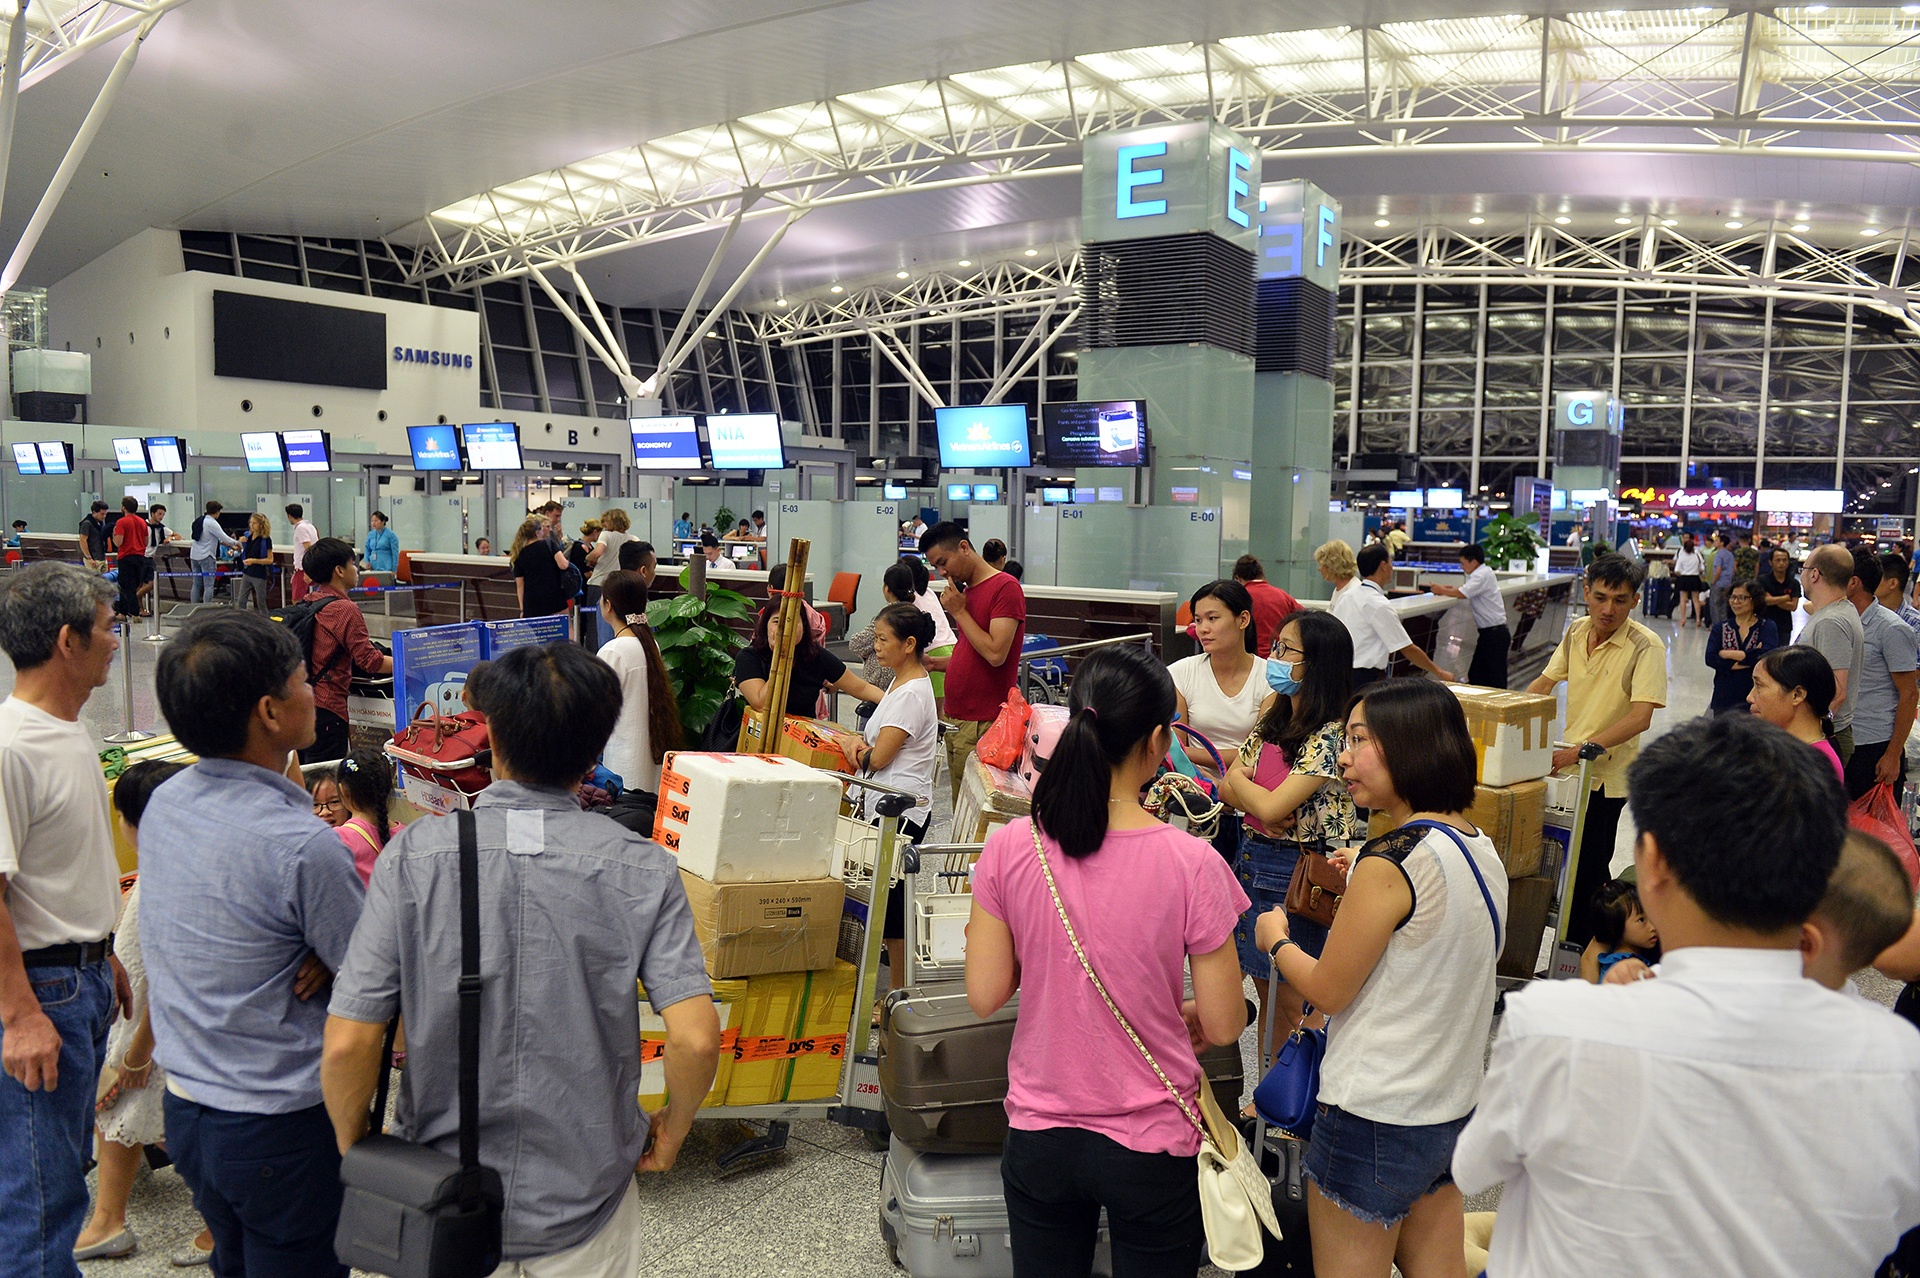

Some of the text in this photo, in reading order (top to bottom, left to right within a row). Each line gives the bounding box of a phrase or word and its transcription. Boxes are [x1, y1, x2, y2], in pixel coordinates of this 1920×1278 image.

[1116, 141, 1168, 219] E
[1227, 146, 1251, 228] E
[1317, 204, 1335, 267] F
[393, 346, 473, 368] SAMSUNG
[1567, 399, 1594, 426] G
[568, 429, 579, 445] B
[782, 504, 799, 513] E-03
[876, 506, 894, 515] E-02
[1062, 509, 1084, 519] E-01
[1190, 512, 1215, 521] E-00
[1560, 963, 1577, 974] 2117
[857, 1082, 879, 1095] 2396
